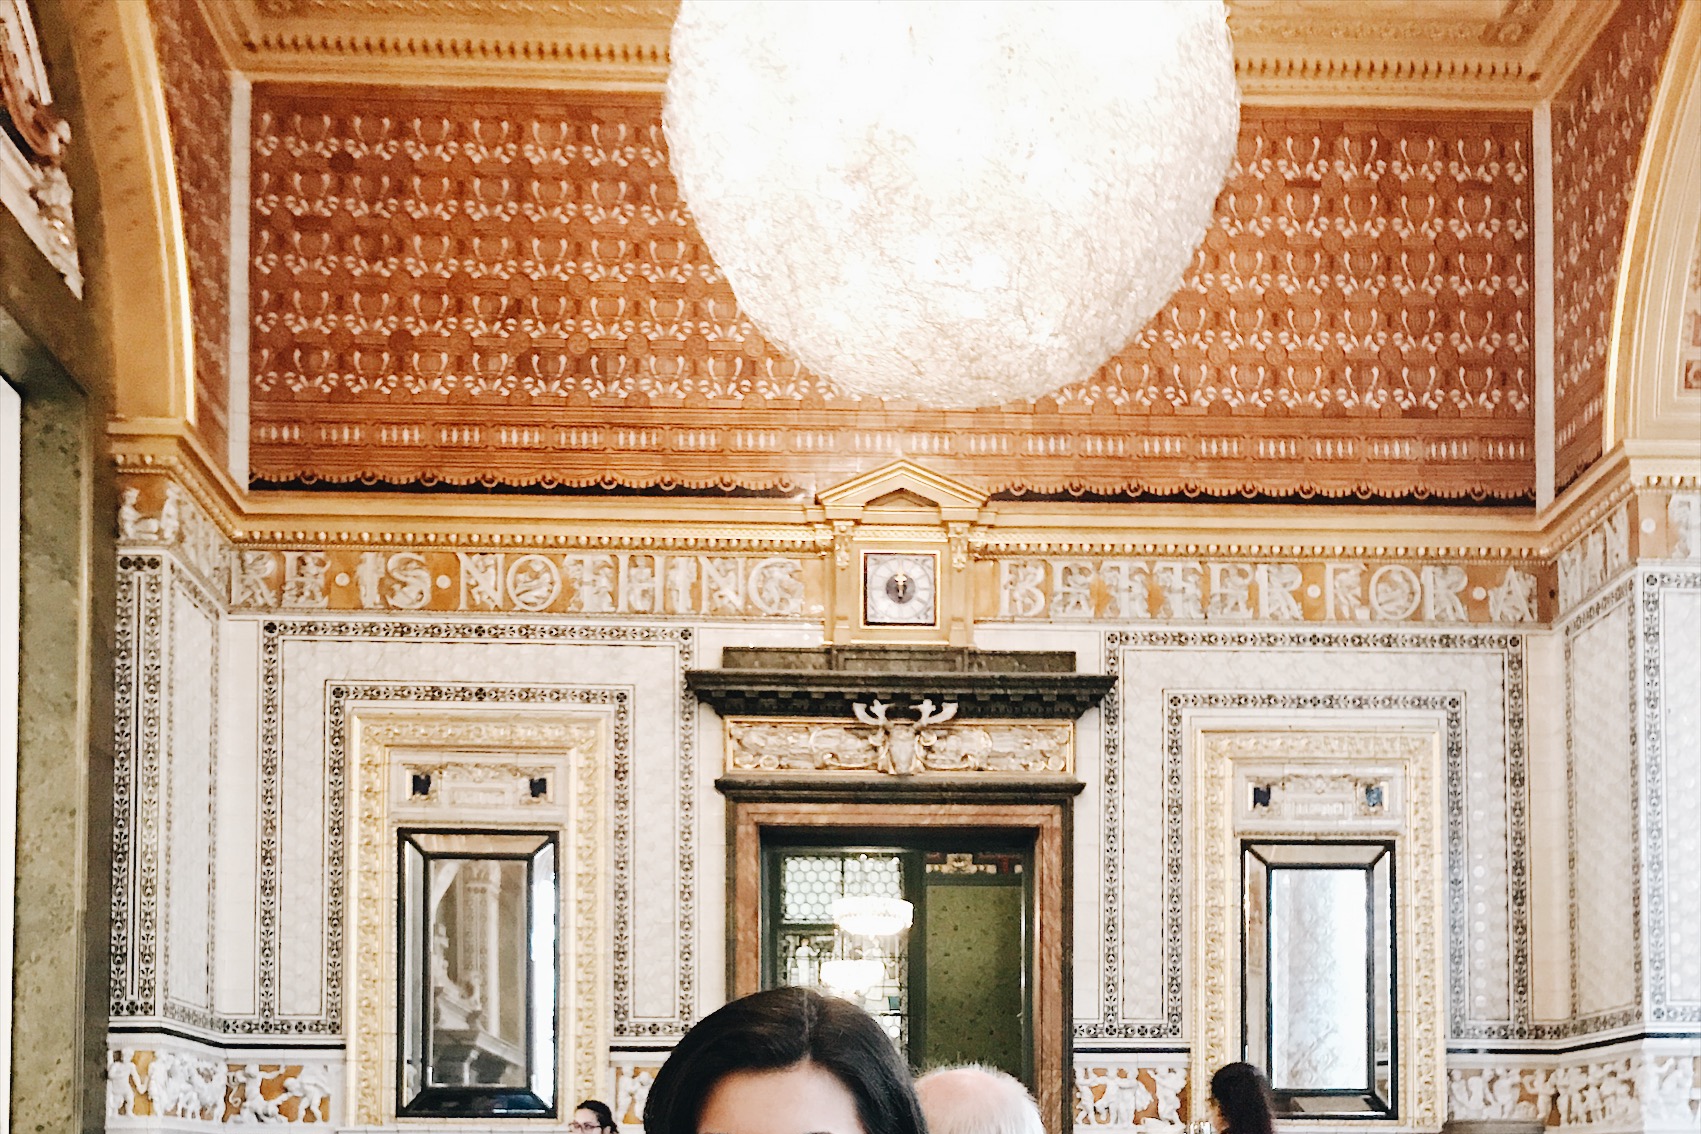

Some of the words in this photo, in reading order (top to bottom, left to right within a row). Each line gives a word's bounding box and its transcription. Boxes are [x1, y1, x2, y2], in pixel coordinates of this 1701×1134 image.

[356, 552, 432, 609] IS
[459, 552, 805, 613] NOTHING
[1000, 562, 1303, 619] BETTER
[1323, 565, 1467, 621] FOR
[1488, 565, 1538, 622] A
